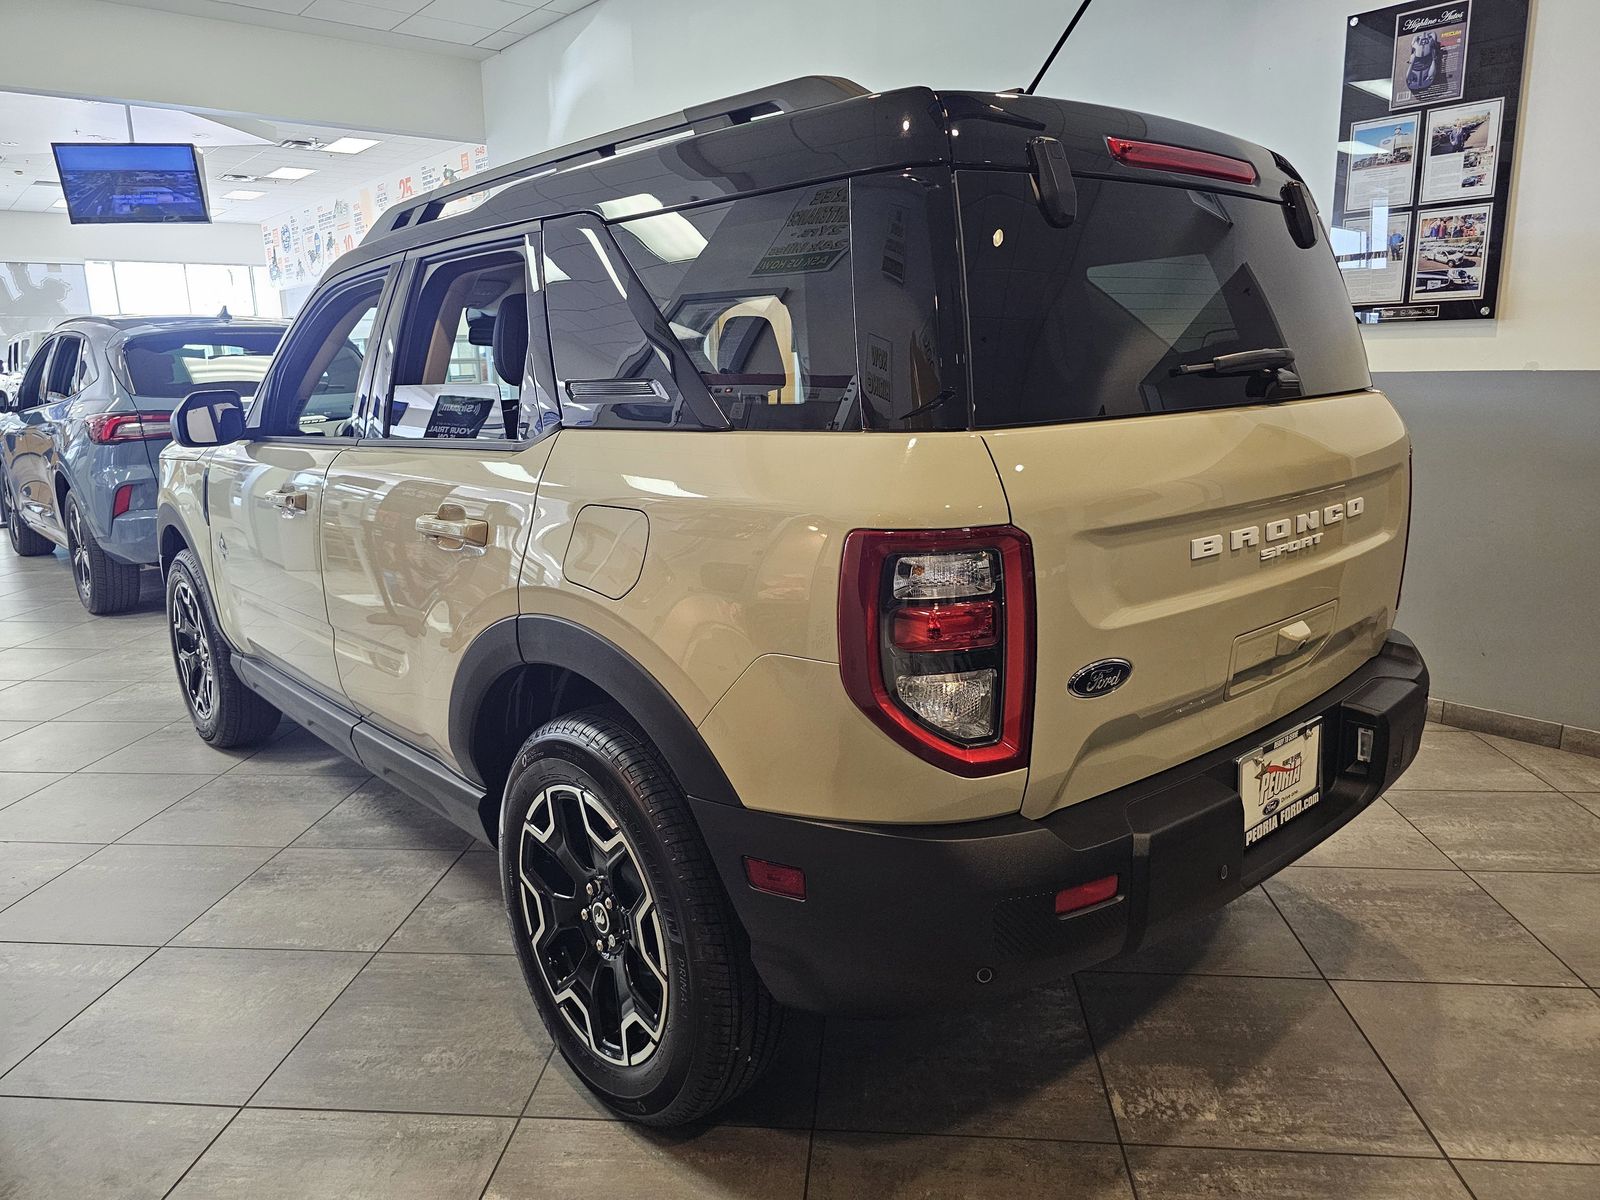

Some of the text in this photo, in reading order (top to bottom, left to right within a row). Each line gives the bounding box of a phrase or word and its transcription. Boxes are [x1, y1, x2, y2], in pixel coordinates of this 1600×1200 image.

[1191, 497, 1364, 560] BRONCO
[1260, 532, 1324, 561] SPORT
[1086, 667, 1122, 692] Ford
[1245, 792, 1319, 847] PEORIA FORD.com
